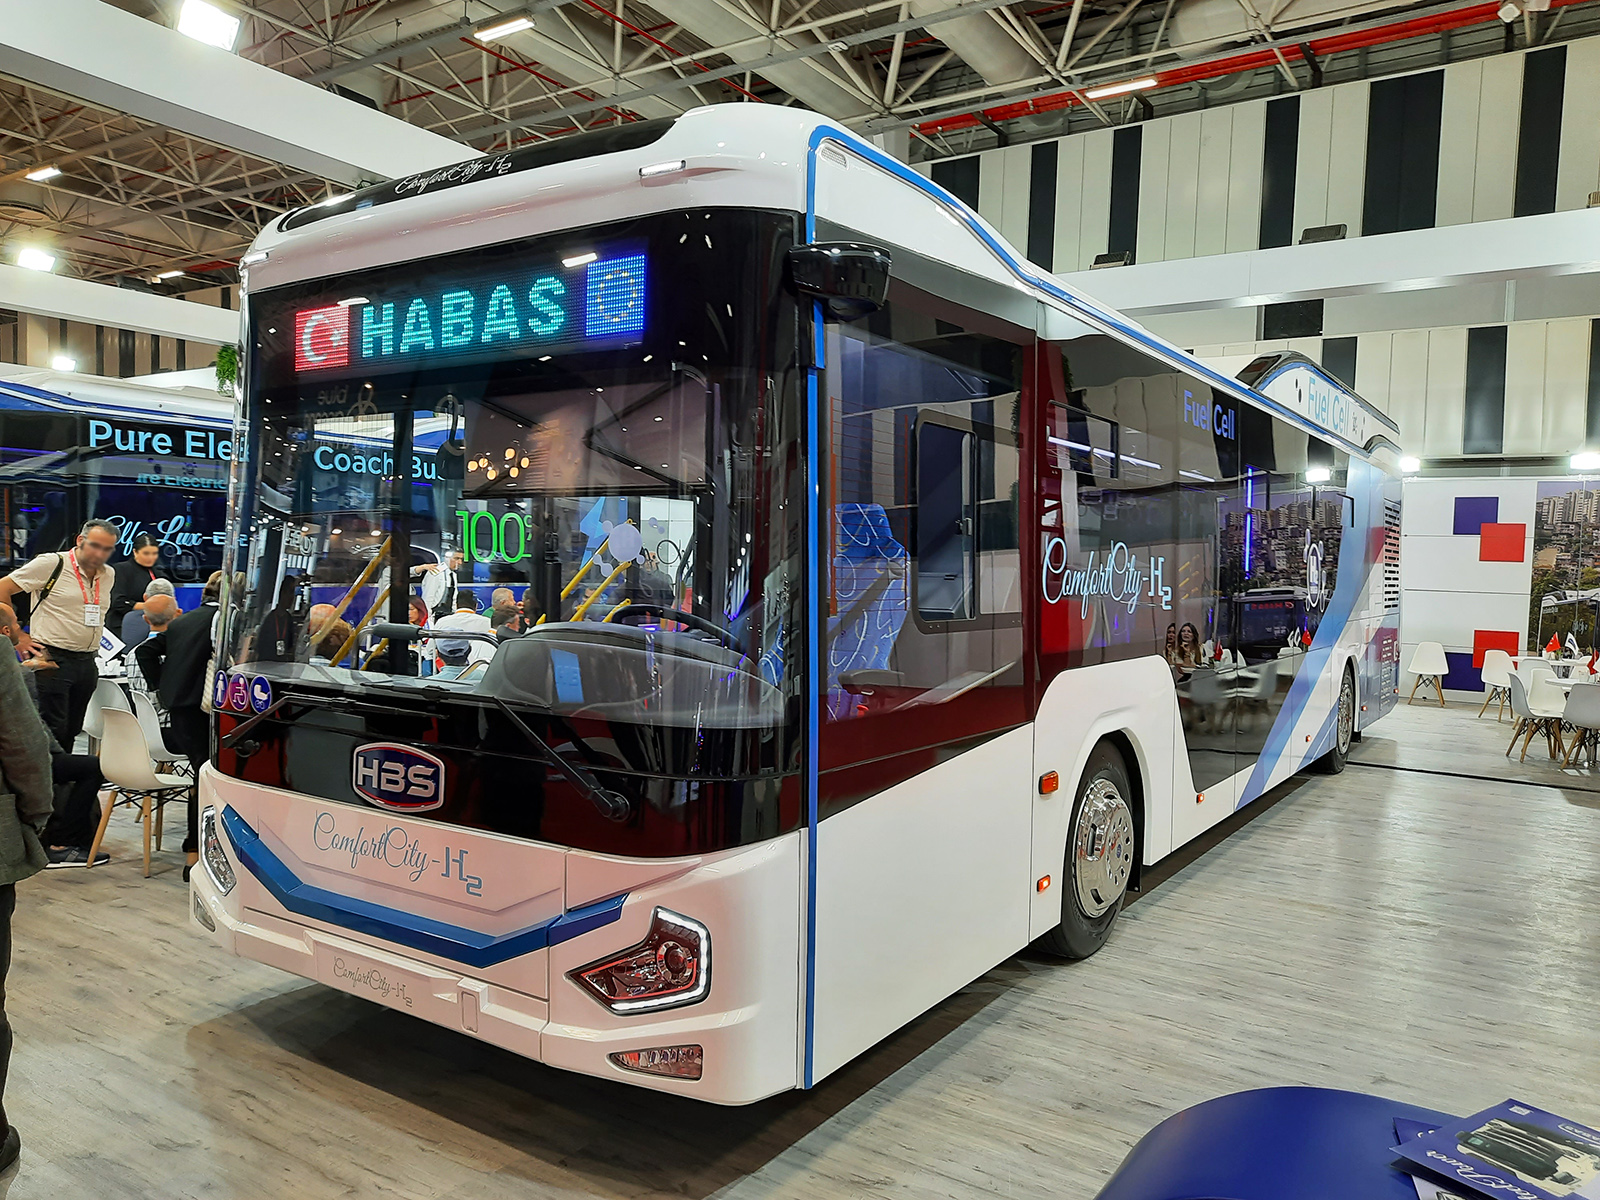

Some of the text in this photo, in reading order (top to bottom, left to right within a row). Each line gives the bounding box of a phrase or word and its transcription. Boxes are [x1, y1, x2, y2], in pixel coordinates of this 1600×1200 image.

[362, 276, 565, 358] HABAS
[1184, 389, 1235, 440] Fuel Cell
[1308, 376, 1331, 426] Fuel
[1332, 394, 1350, 437] Cell
[89, 419, 172, 455] Pure
[314, 446, 394, 476] Coach
[411, 456, 446, 481] Bu
[1042, 534, 1172, 620] ComfortCity-H2
[357, 756, 435, 798] HBS
[313, 810, 482, 897] ComfortCity-H2
[333, 956, 413, 1008] ComfortCity-H2
